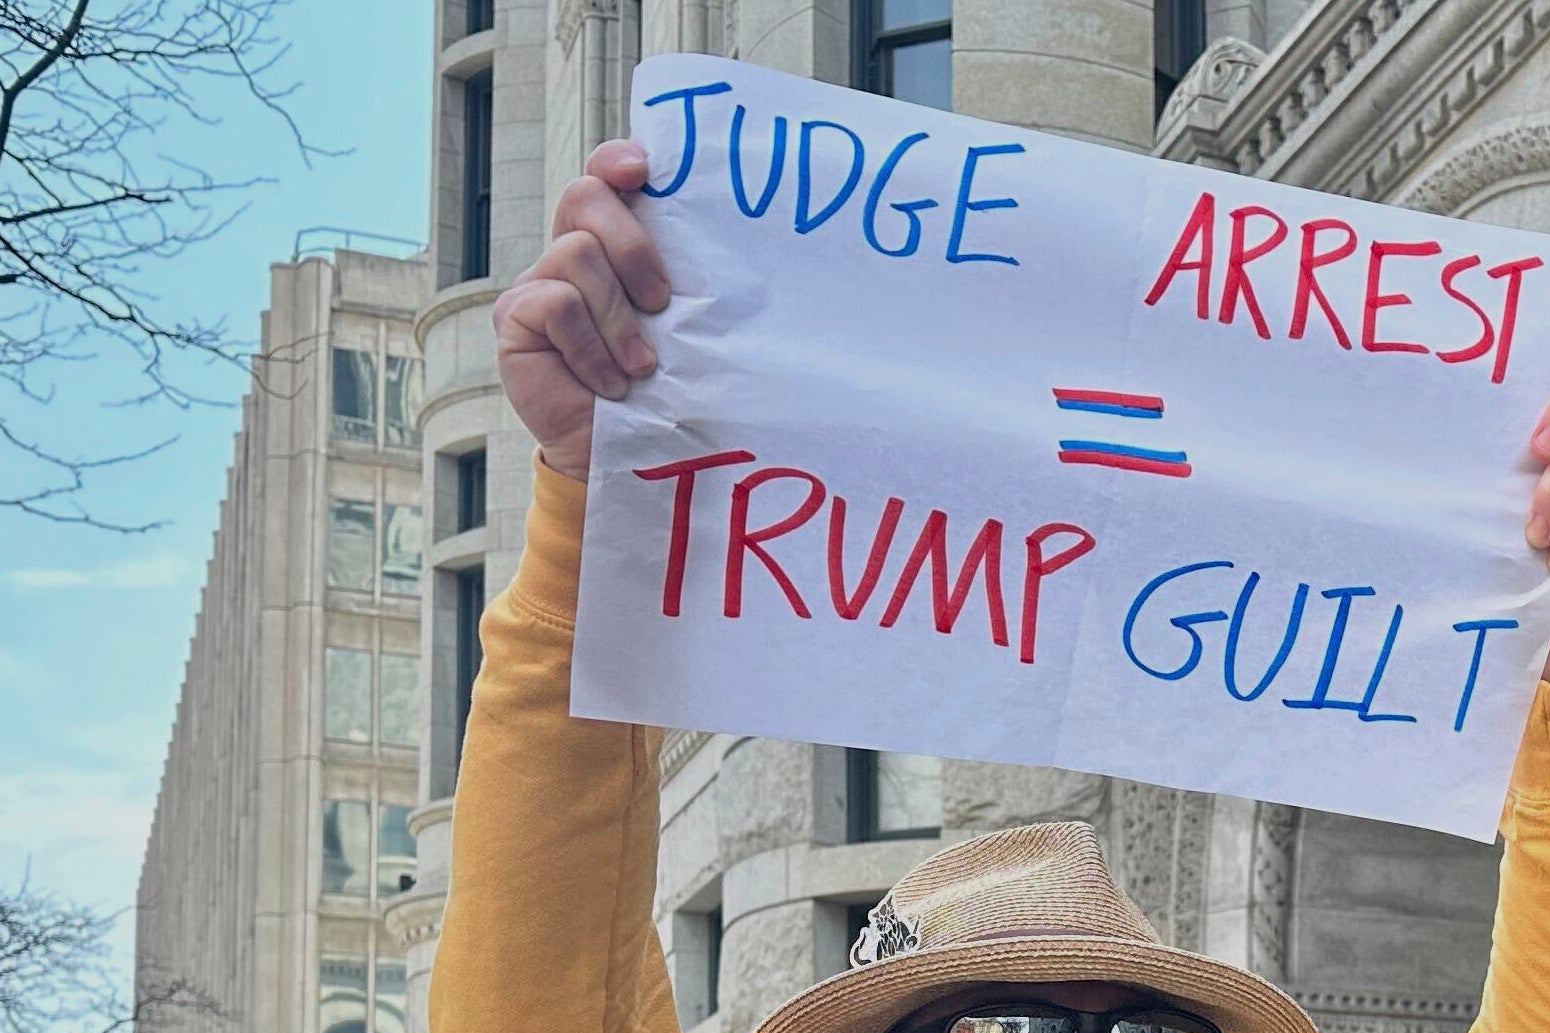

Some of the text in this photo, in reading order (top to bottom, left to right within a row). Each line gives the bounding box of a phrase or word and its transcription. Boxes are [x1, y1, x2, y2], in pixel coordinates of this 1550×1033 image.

[641, 81, 1544, 384] JUDGE ARREST
[634, 450, 1520, 733] TRUMP GUILT
